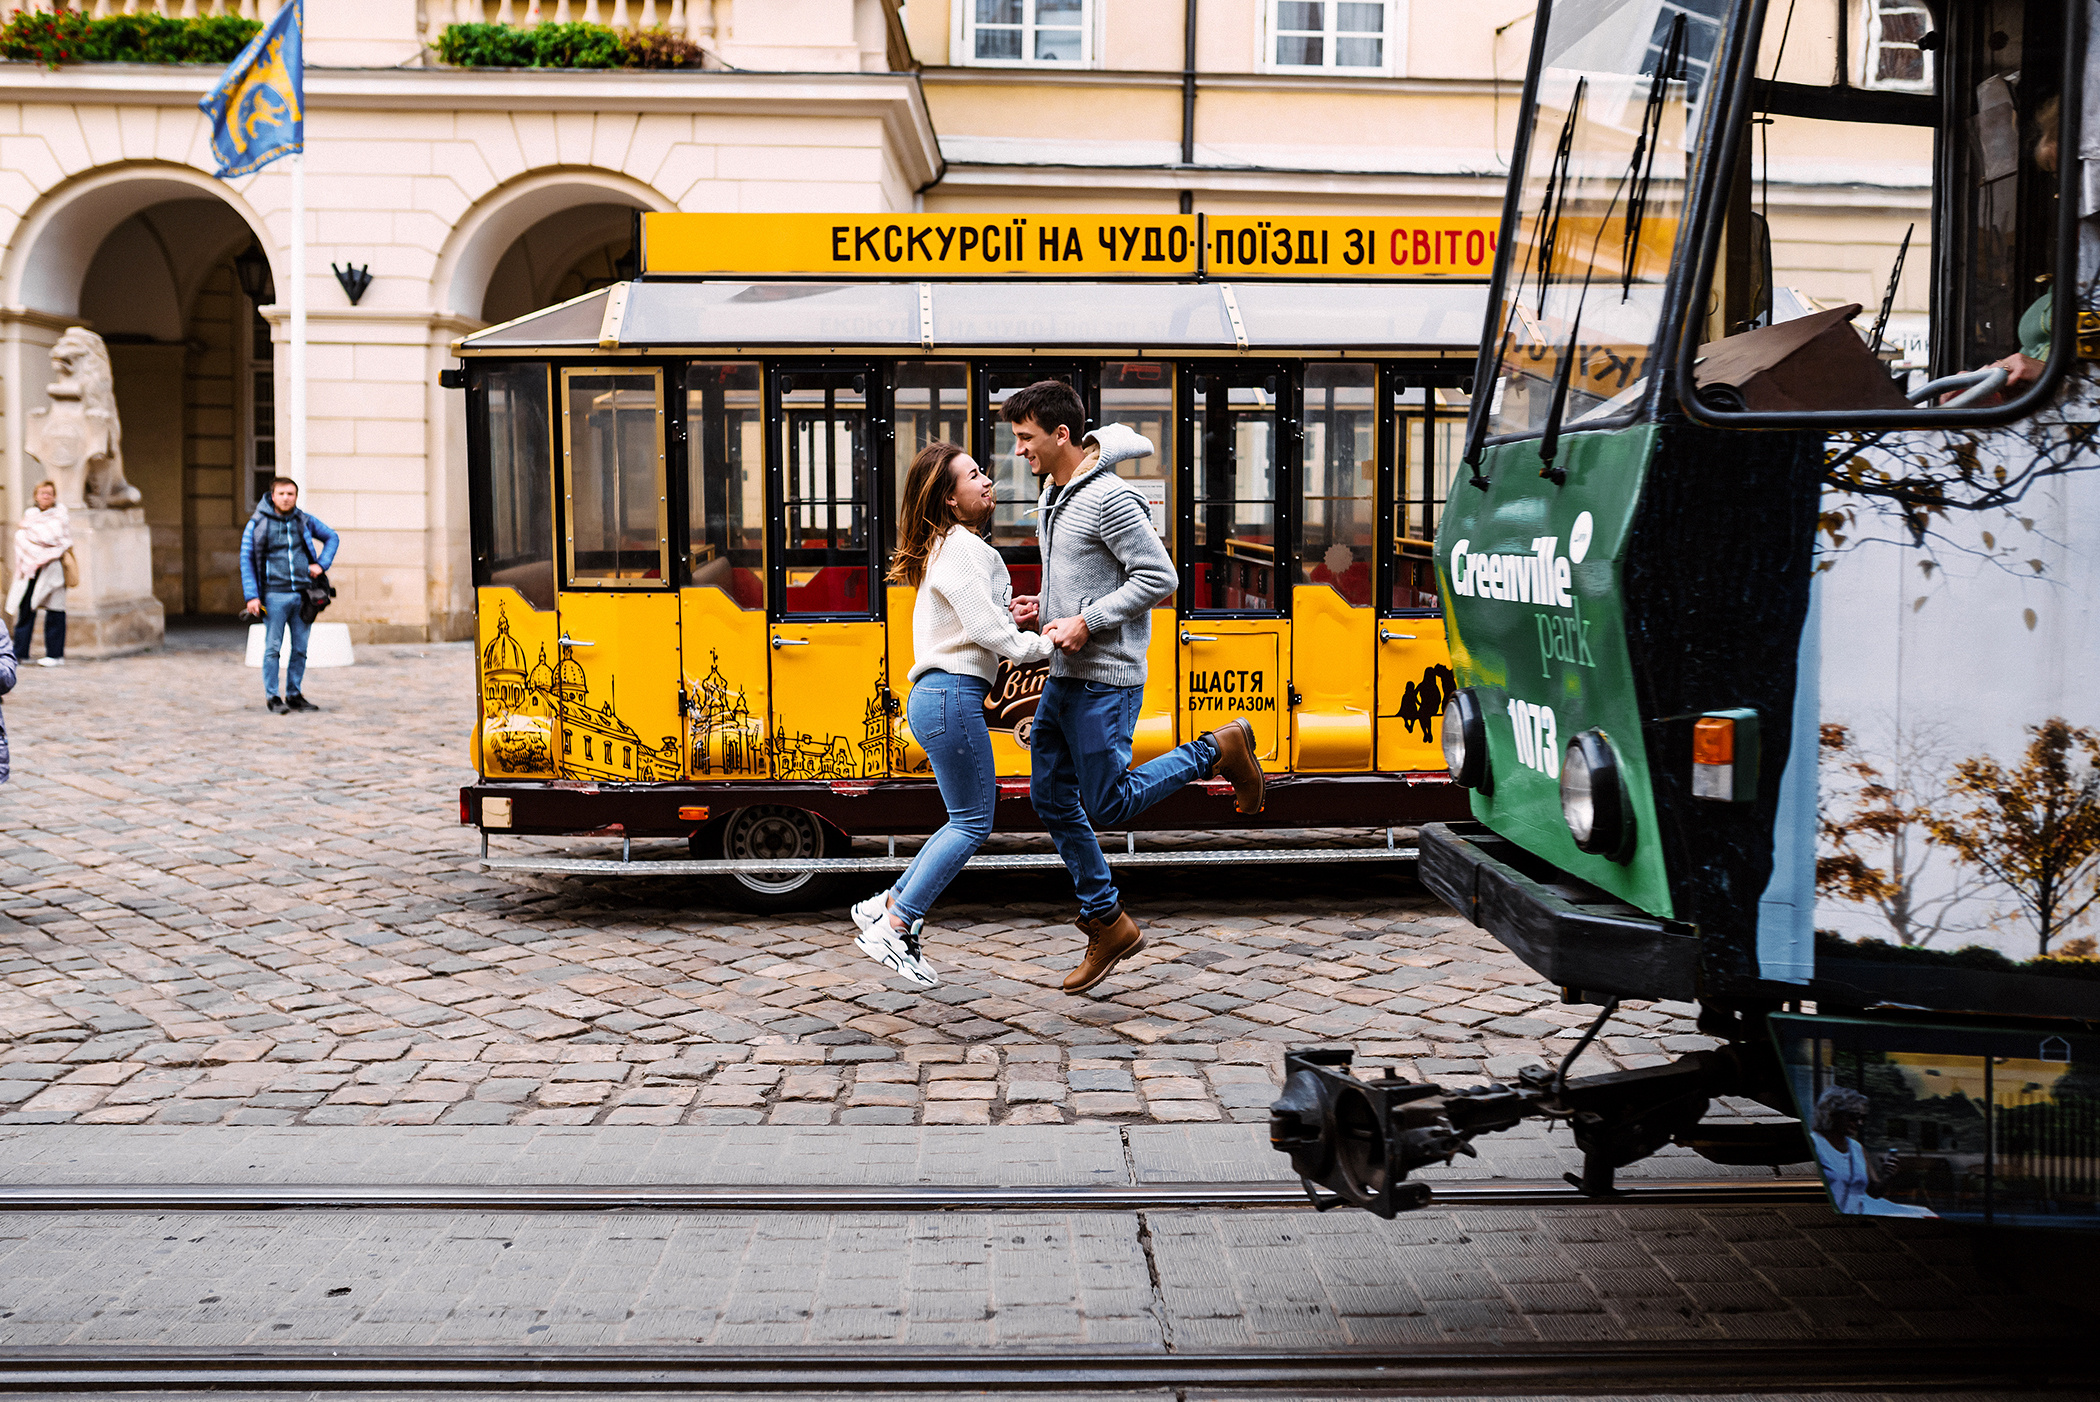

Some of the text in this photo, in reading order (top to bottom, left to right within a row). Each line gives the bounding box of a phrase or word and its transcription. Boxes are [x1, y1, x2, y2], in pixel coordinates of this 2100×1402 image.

[832, 219, 1026, 263] ЕКСКУРСІЇ
[1039, 226, 1084, 262] НА
[1343, 229, 1375, 265] ЗІ
[1451, 536, 1573, 608] Greenville
[1534, 595, 1596, 679] park
[984, 660, 1050, 710] Світ
[1188, 696, 1275, 712] БУТИ РАЗОМ
[1189, 670, 1263, 694] ЩАСТЯ
[1507, 698, 1560, 780] 1073
